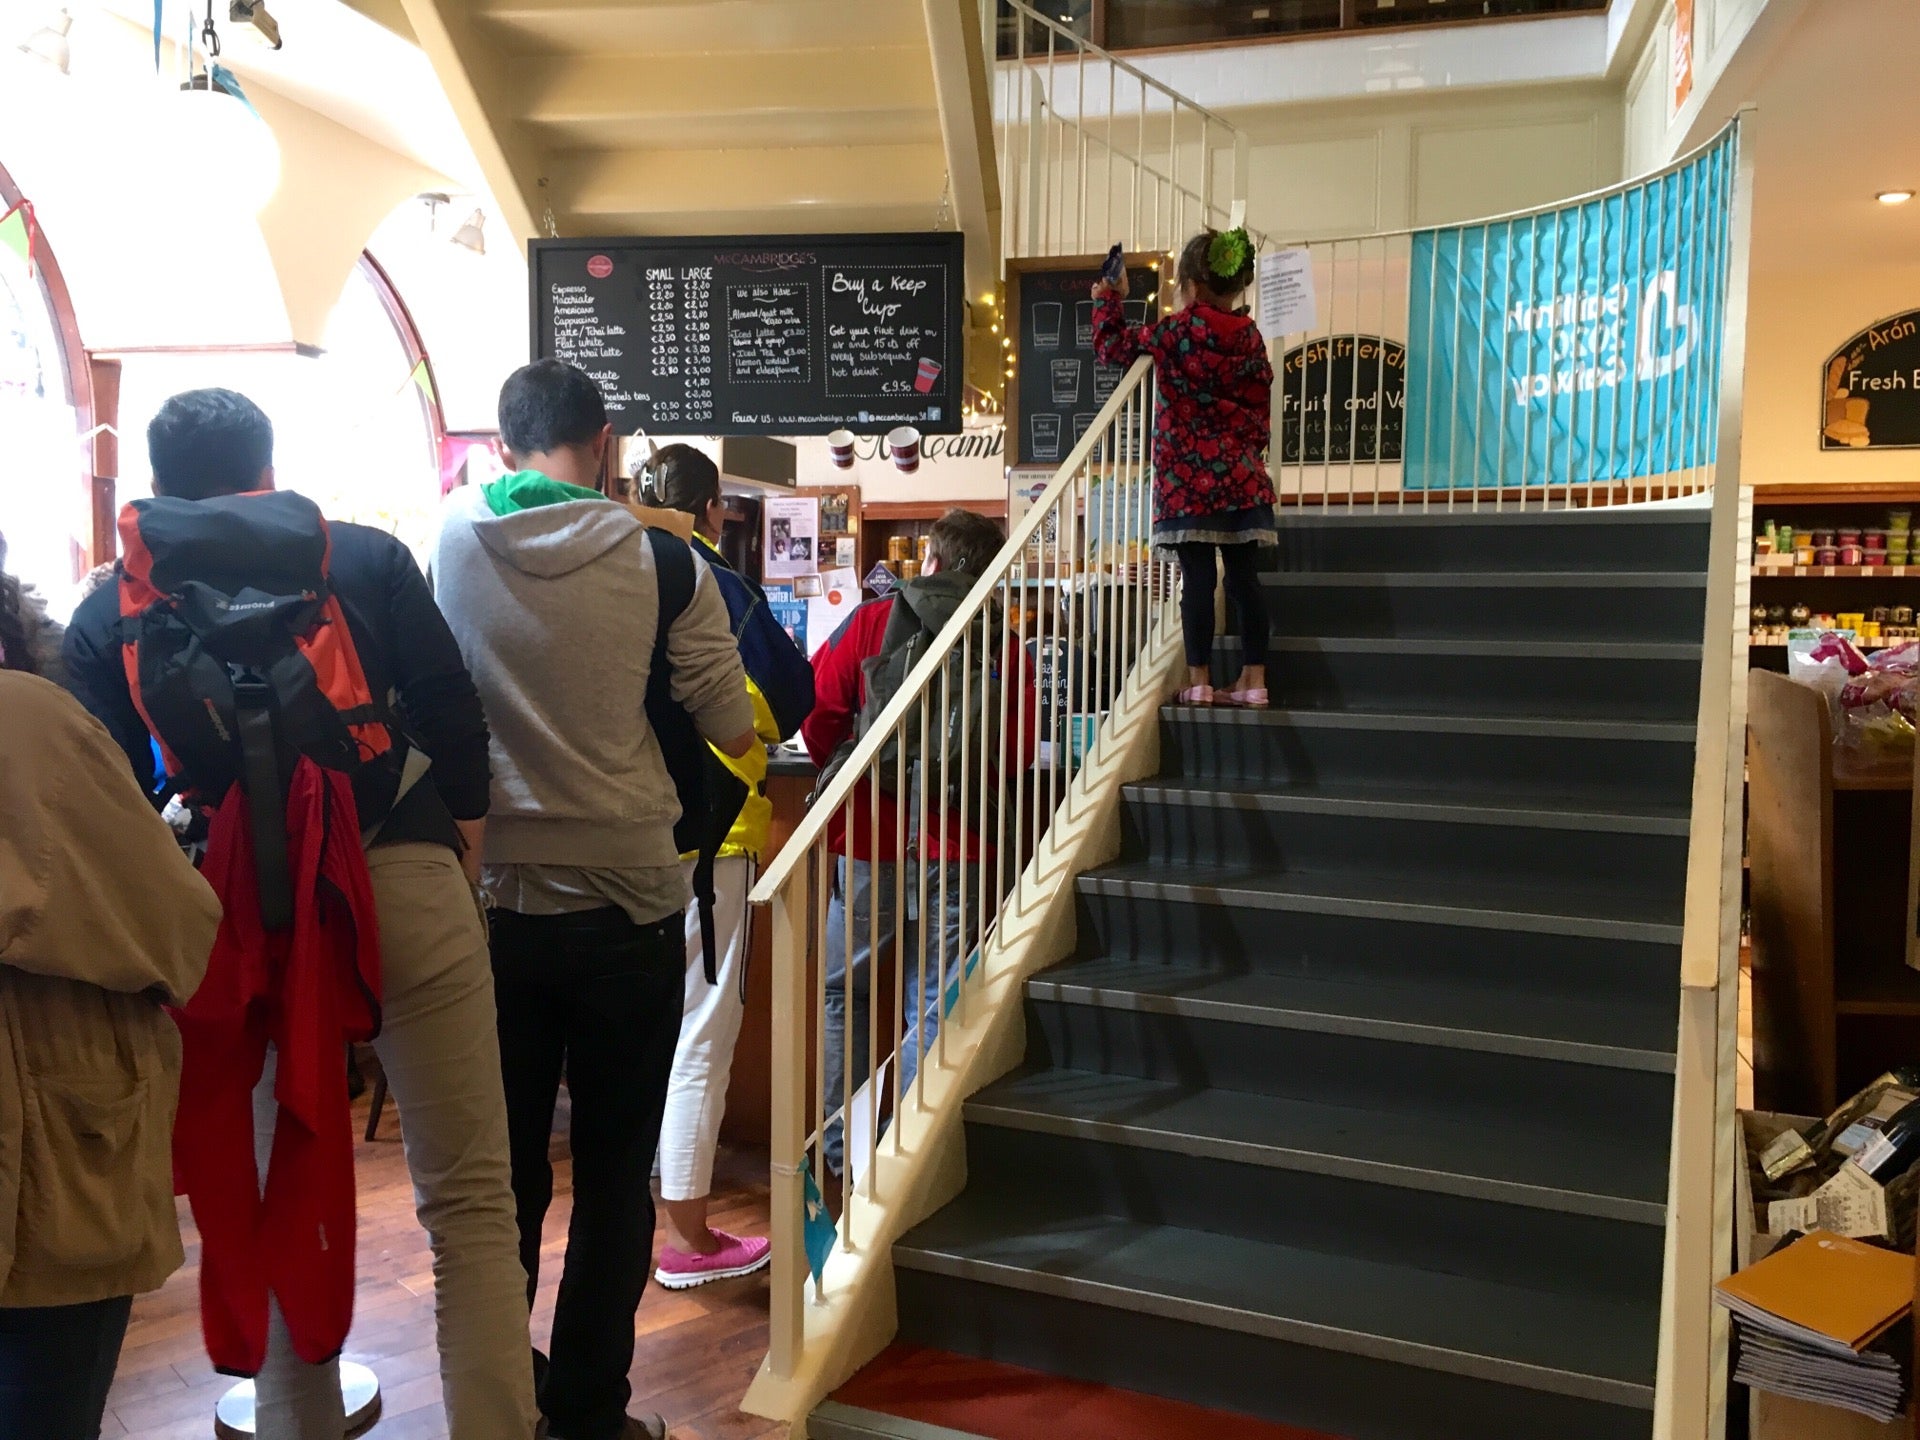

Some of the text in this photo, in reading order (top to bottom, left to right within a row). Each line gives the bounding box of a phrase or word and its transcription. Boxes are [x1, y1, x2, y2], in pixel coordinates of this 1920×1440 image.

[646, 267, 713, 281] SMALL LARGE
[832, 273, 926, 303] Buy a Keep
[829, 325, 846, 336] Get
[1868, 319, 1916, 351] Arán
[555, 337, 604, 349] Flat white
[849, 339, 870, 349] and
[906, 338, 921, 349] off
[832, 368, 848, 377] hot
[599, 380, 617, 390] Tea
[1850, 369, 1906, 391] Fresh
[634, 392, 650, 401] teas
[1284, 394, 1328, 412] Fruit
[1344, 391, 1377, 410] and
